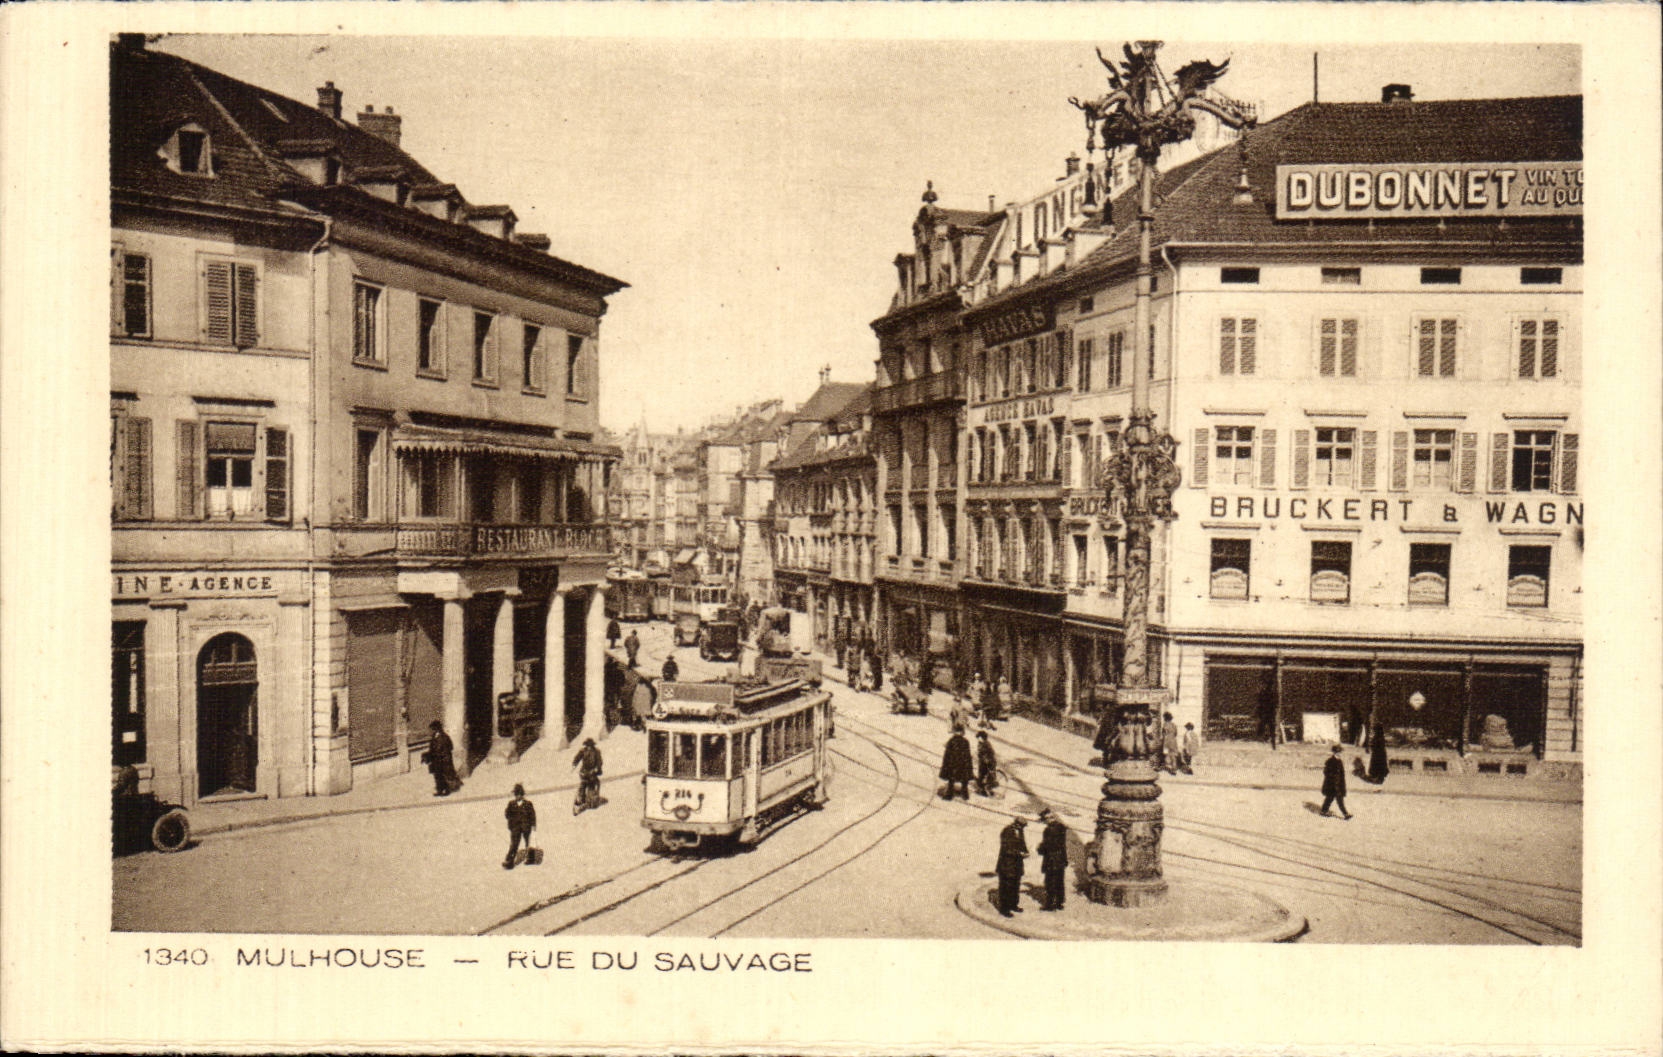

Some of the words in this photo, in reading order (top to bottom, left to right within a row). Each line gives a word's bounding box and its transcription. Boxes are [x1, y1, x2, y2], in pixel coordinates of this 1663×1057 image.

[1287, 169, 1516, 210] DUBONNET
[1525, 169, 1558, 187] VIN
[1522, 188, 1549, 205] AU
[1555, 188, 1584, 207] QU
[1016, 157, 1138, 250] LONGNES
[1210, 497, 1413, 522] BRUCKERT
[1486, 501, 1583, 524] WAGN
[477, 527, 559, 552] RESTAURANT
[189, 576, 272, 590] AGENCE
